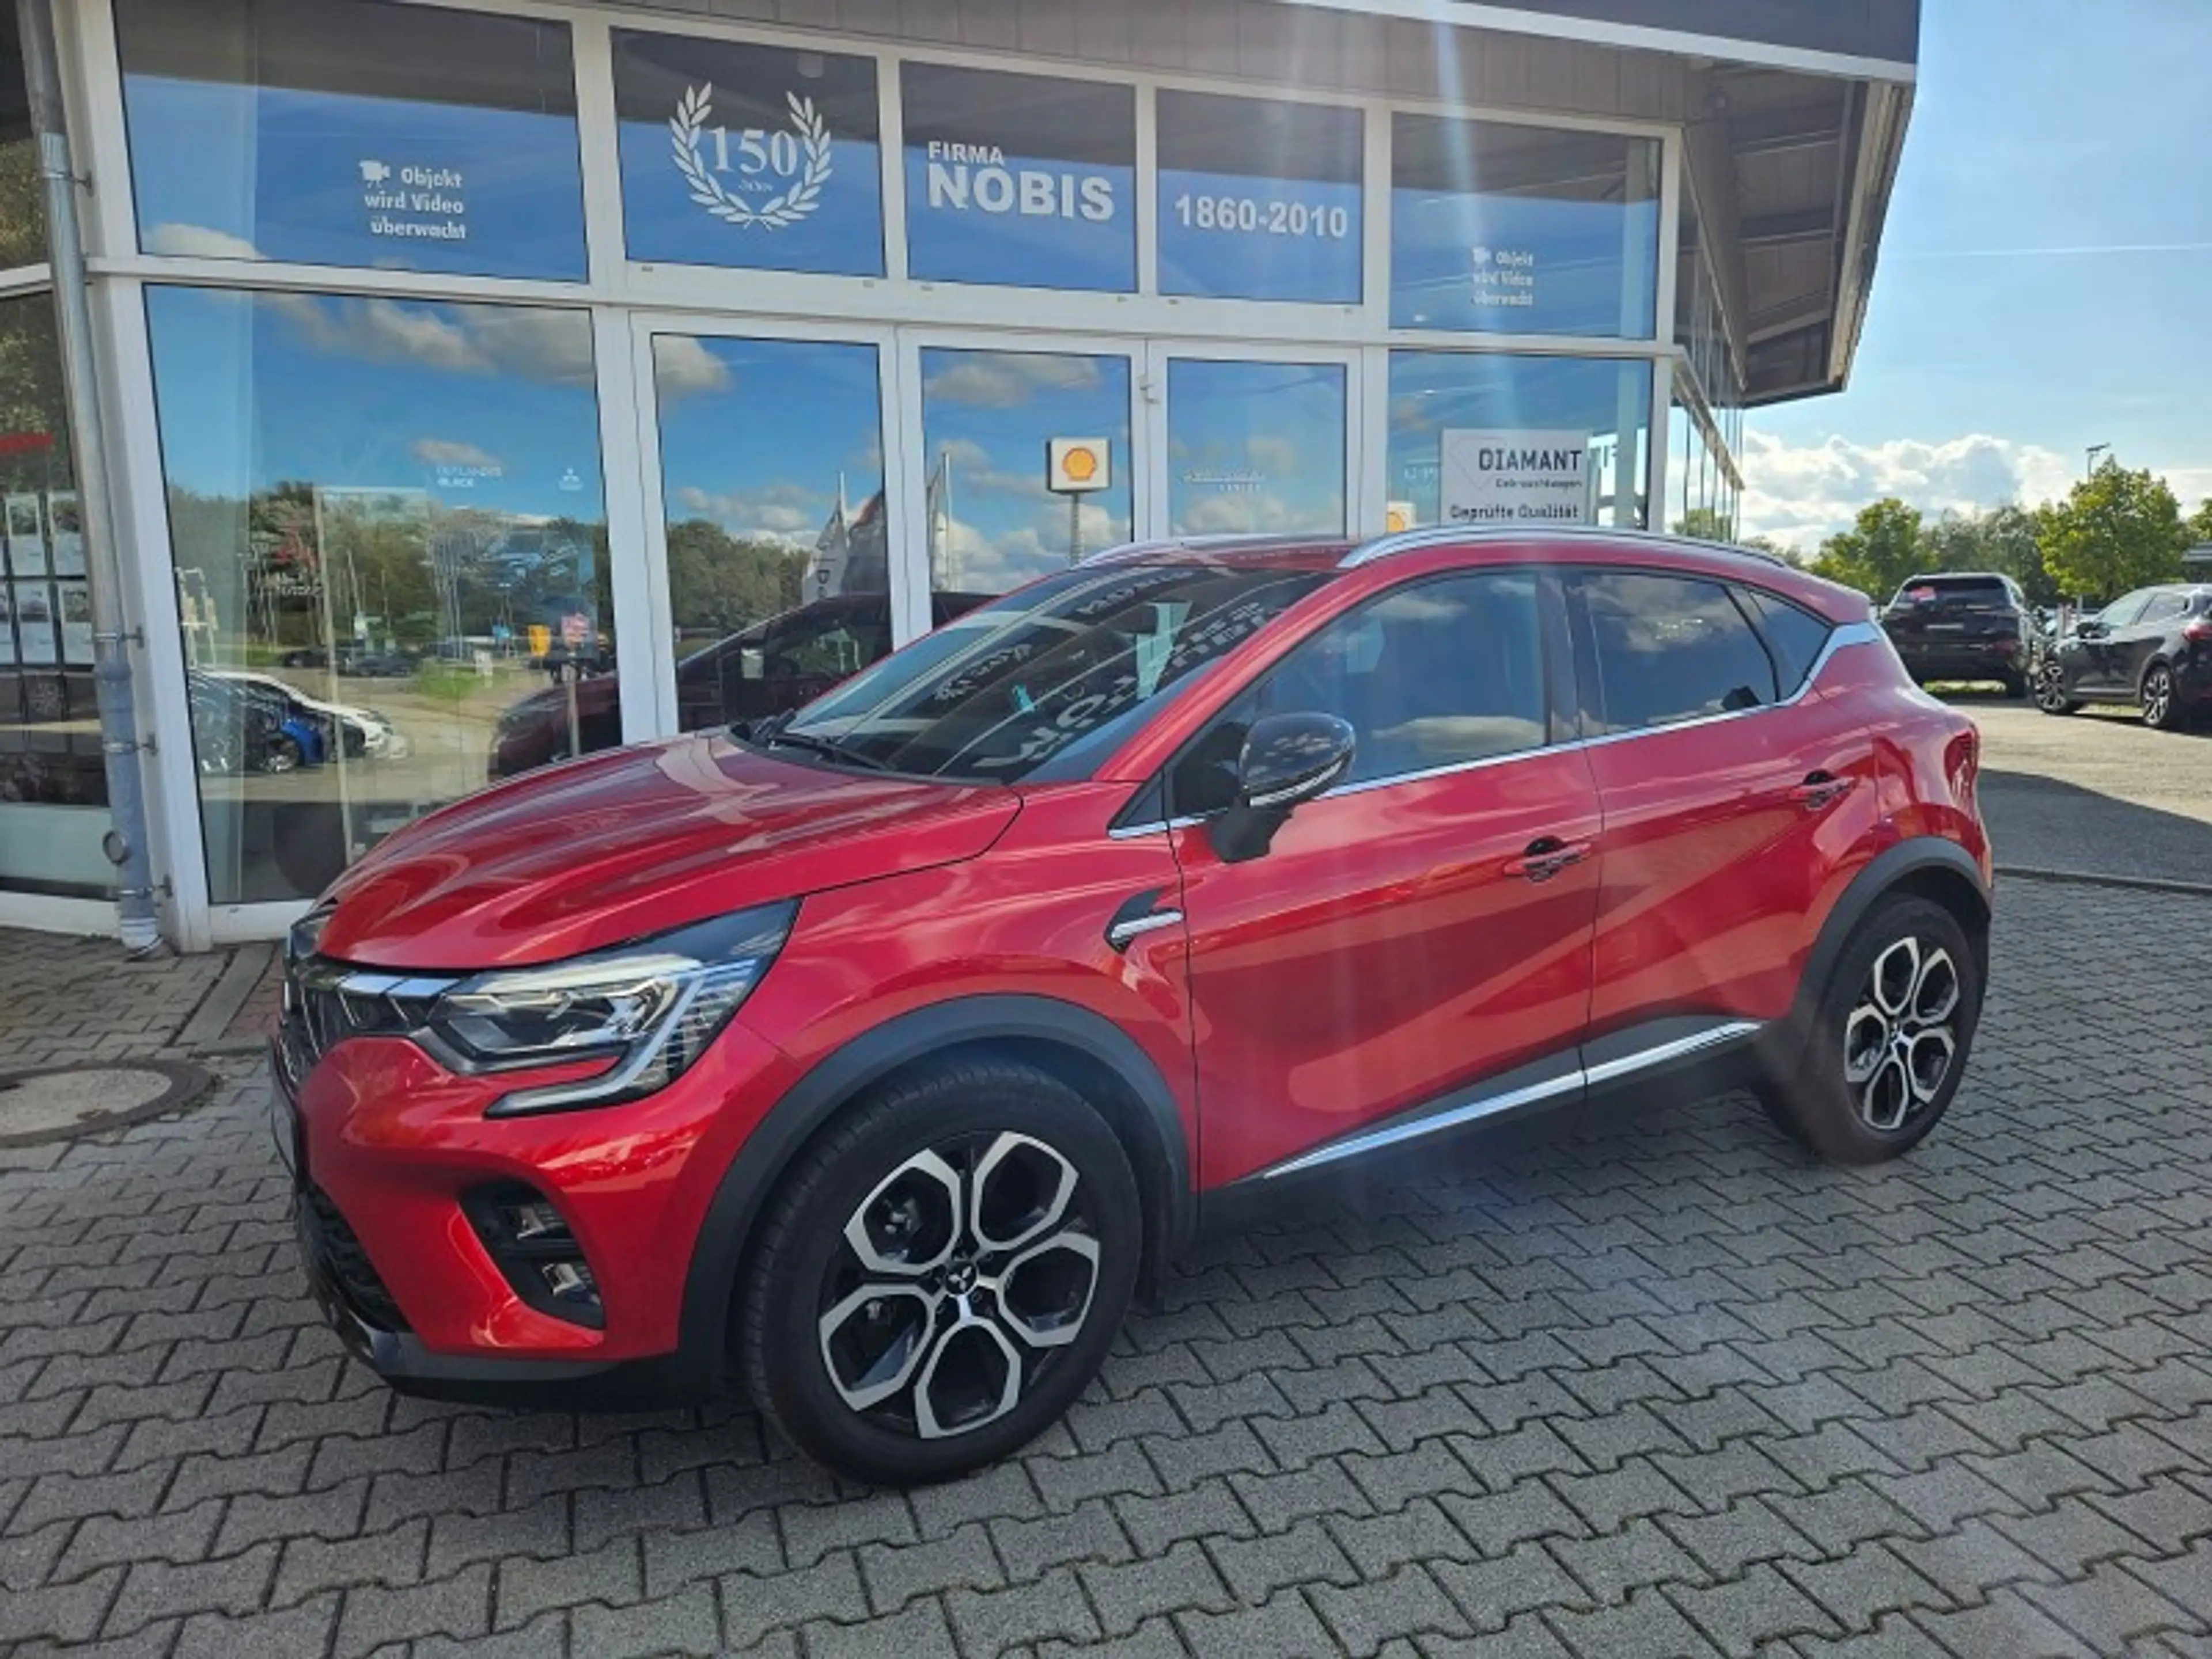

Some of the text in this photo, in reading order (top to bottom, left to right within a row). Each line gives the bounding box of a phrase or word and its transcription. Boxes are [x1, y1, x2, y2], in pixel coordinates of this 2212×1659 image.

[708, 126, 798, 177] 150
[927, 141, 1005, 166] FIRMA
[401, 166, 462, 189] Objekt
[365, 190, 464, 214] wird Video
[928, 164, 1115, 221] NOBIS
[370, 215, 465, 238] überwacht
[1175, 194, 1347, 238] 1860-2010
[1478, 448, 1582, 471] DIAMANT
